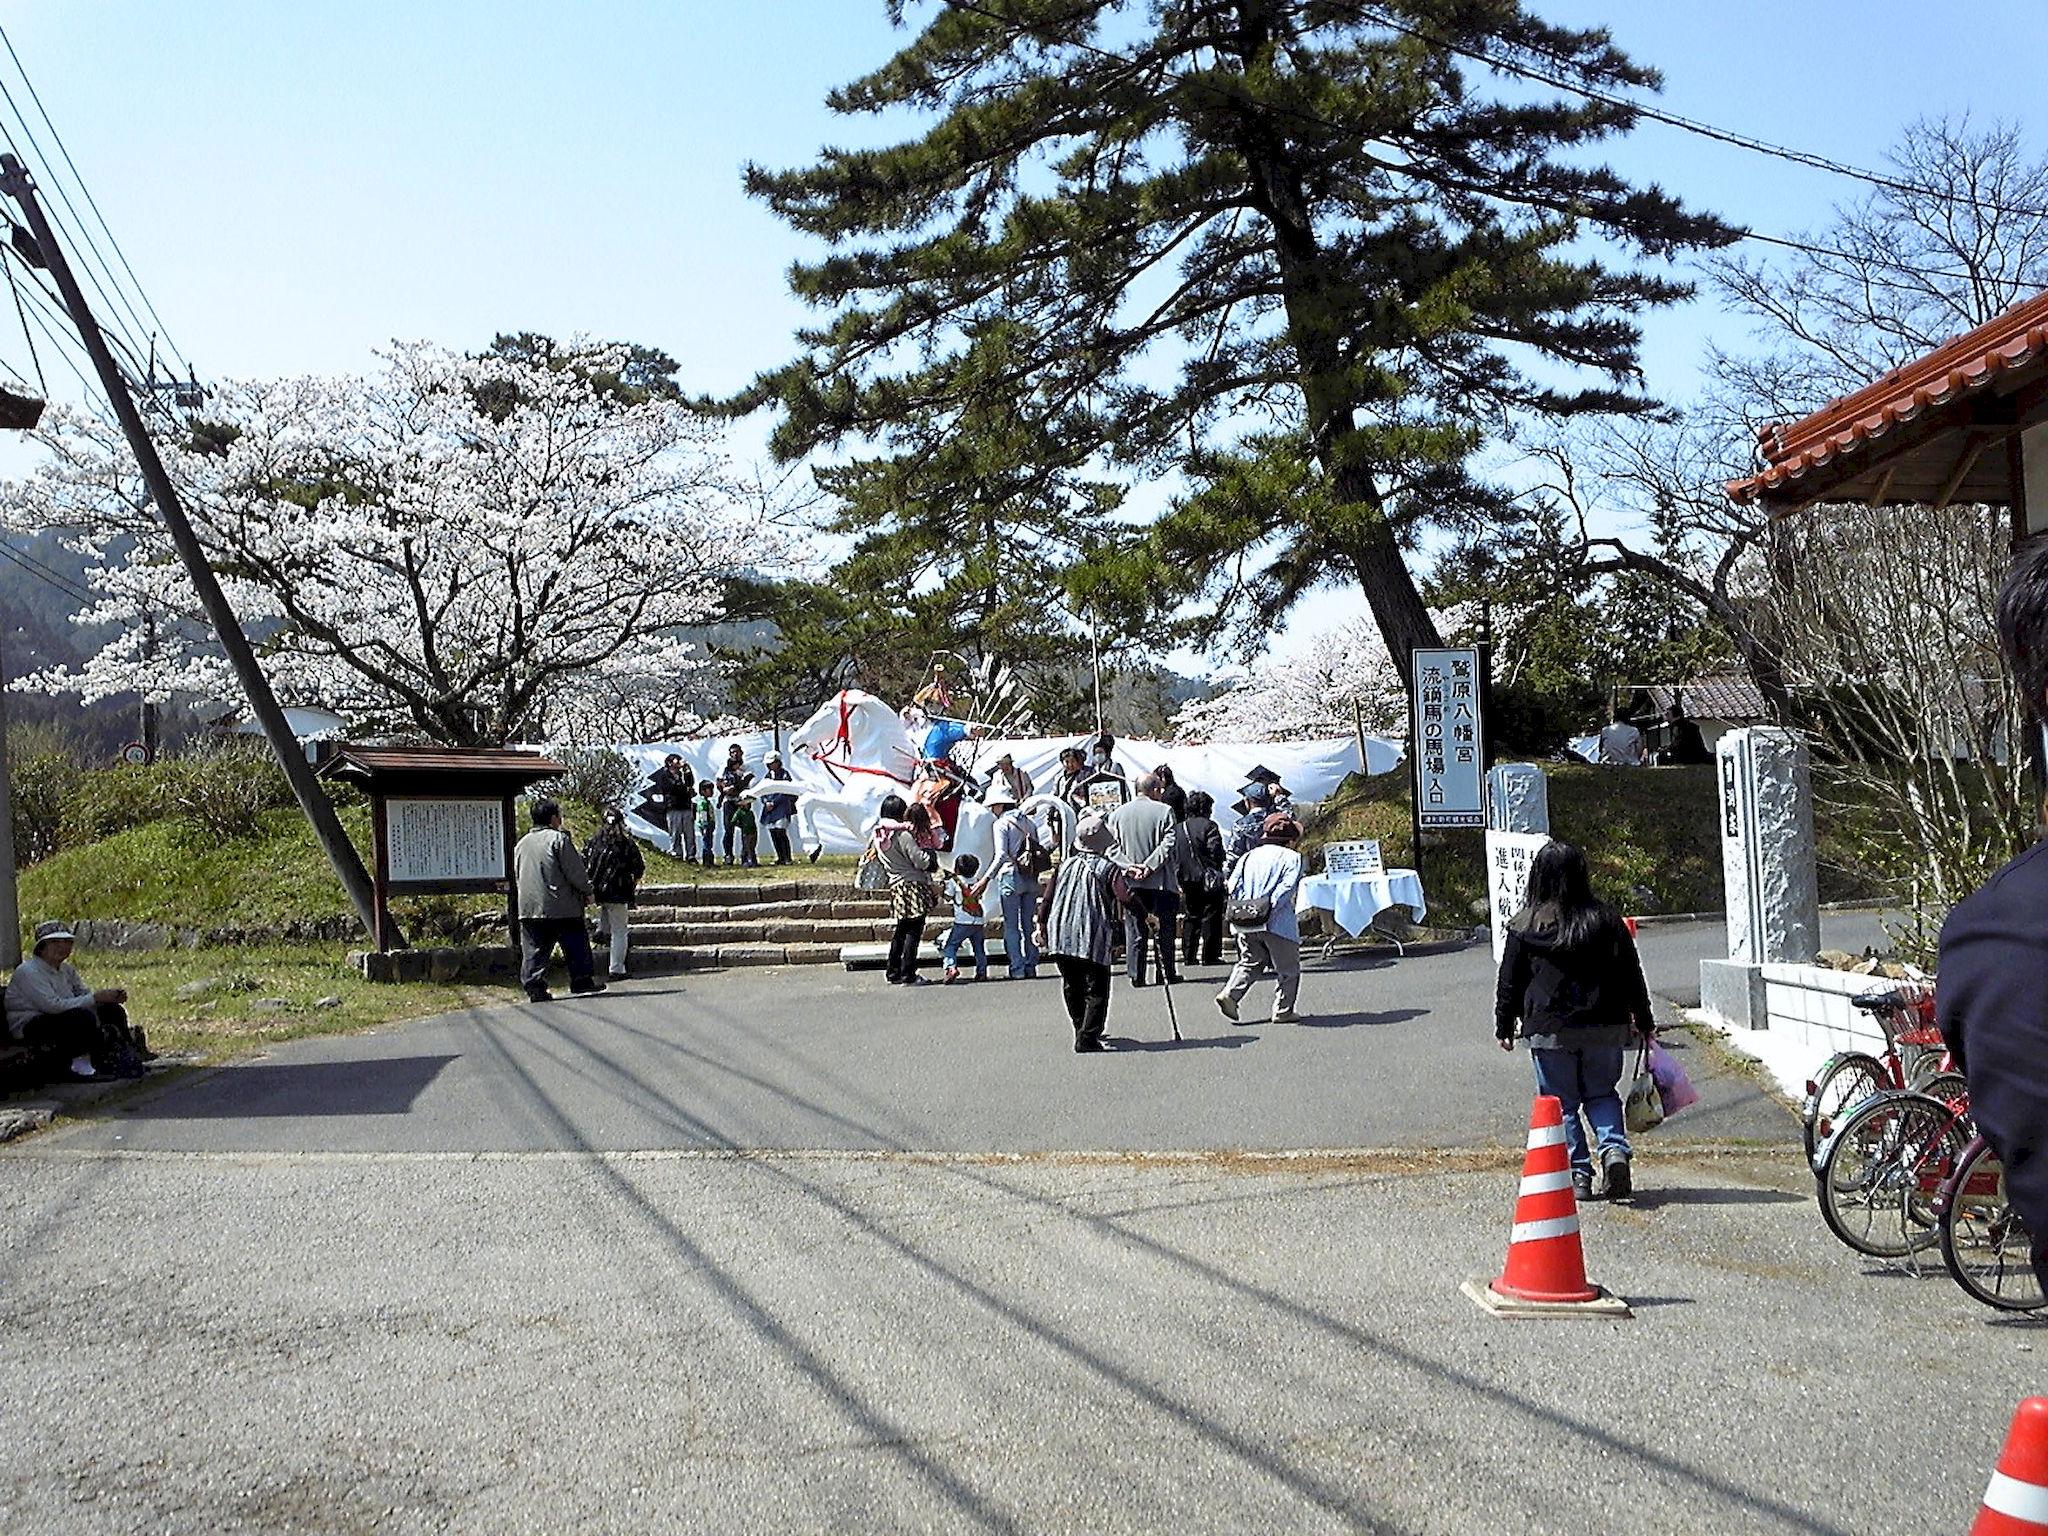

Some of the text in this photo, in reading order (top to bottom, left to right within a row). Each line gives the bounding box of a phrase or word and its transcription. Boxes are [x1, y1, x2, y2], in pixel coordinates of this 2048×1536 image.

[1452, 660, 1474, 763] 鷲原八幡宮
